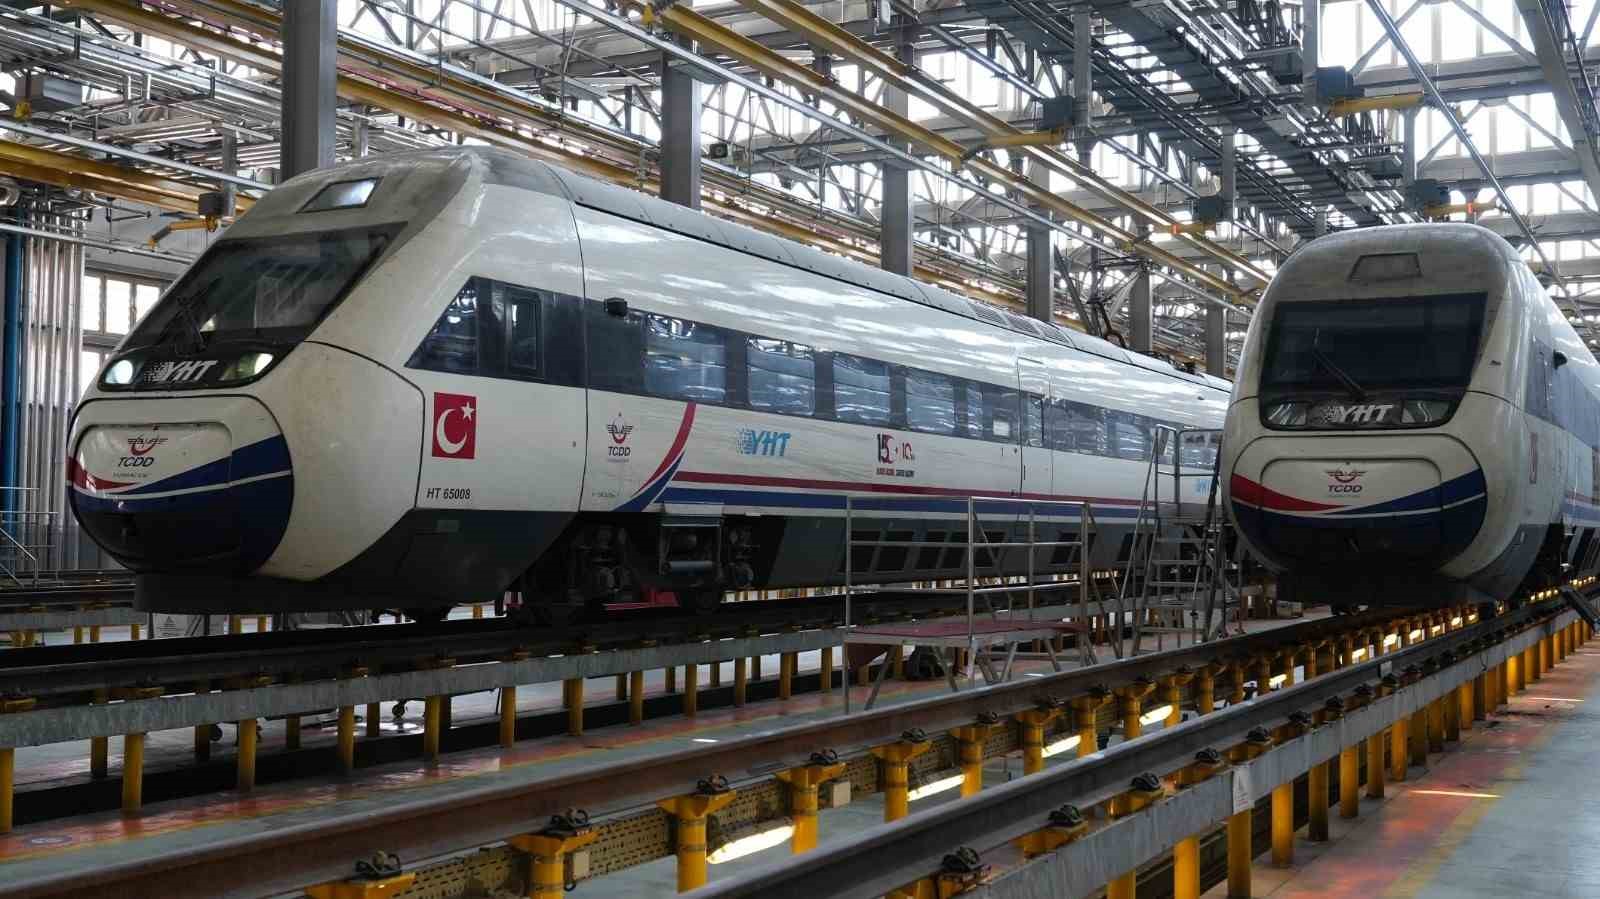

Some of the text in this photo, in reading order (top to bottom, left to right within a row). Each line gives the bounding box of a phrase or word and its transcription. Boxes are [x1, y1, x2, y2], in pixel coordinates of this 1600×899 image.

[160, 360, 218, 381] YHT
[1335, 404, 1394, 422] YHT
[750, 430, 791, 456] YHT
[607, 446, 631, 457] TCDD
[118, 456, 155, 468] TCDD
[427, 487, 471, 500] HT 65008
[1328, 484, 1362, 493] TCDD
